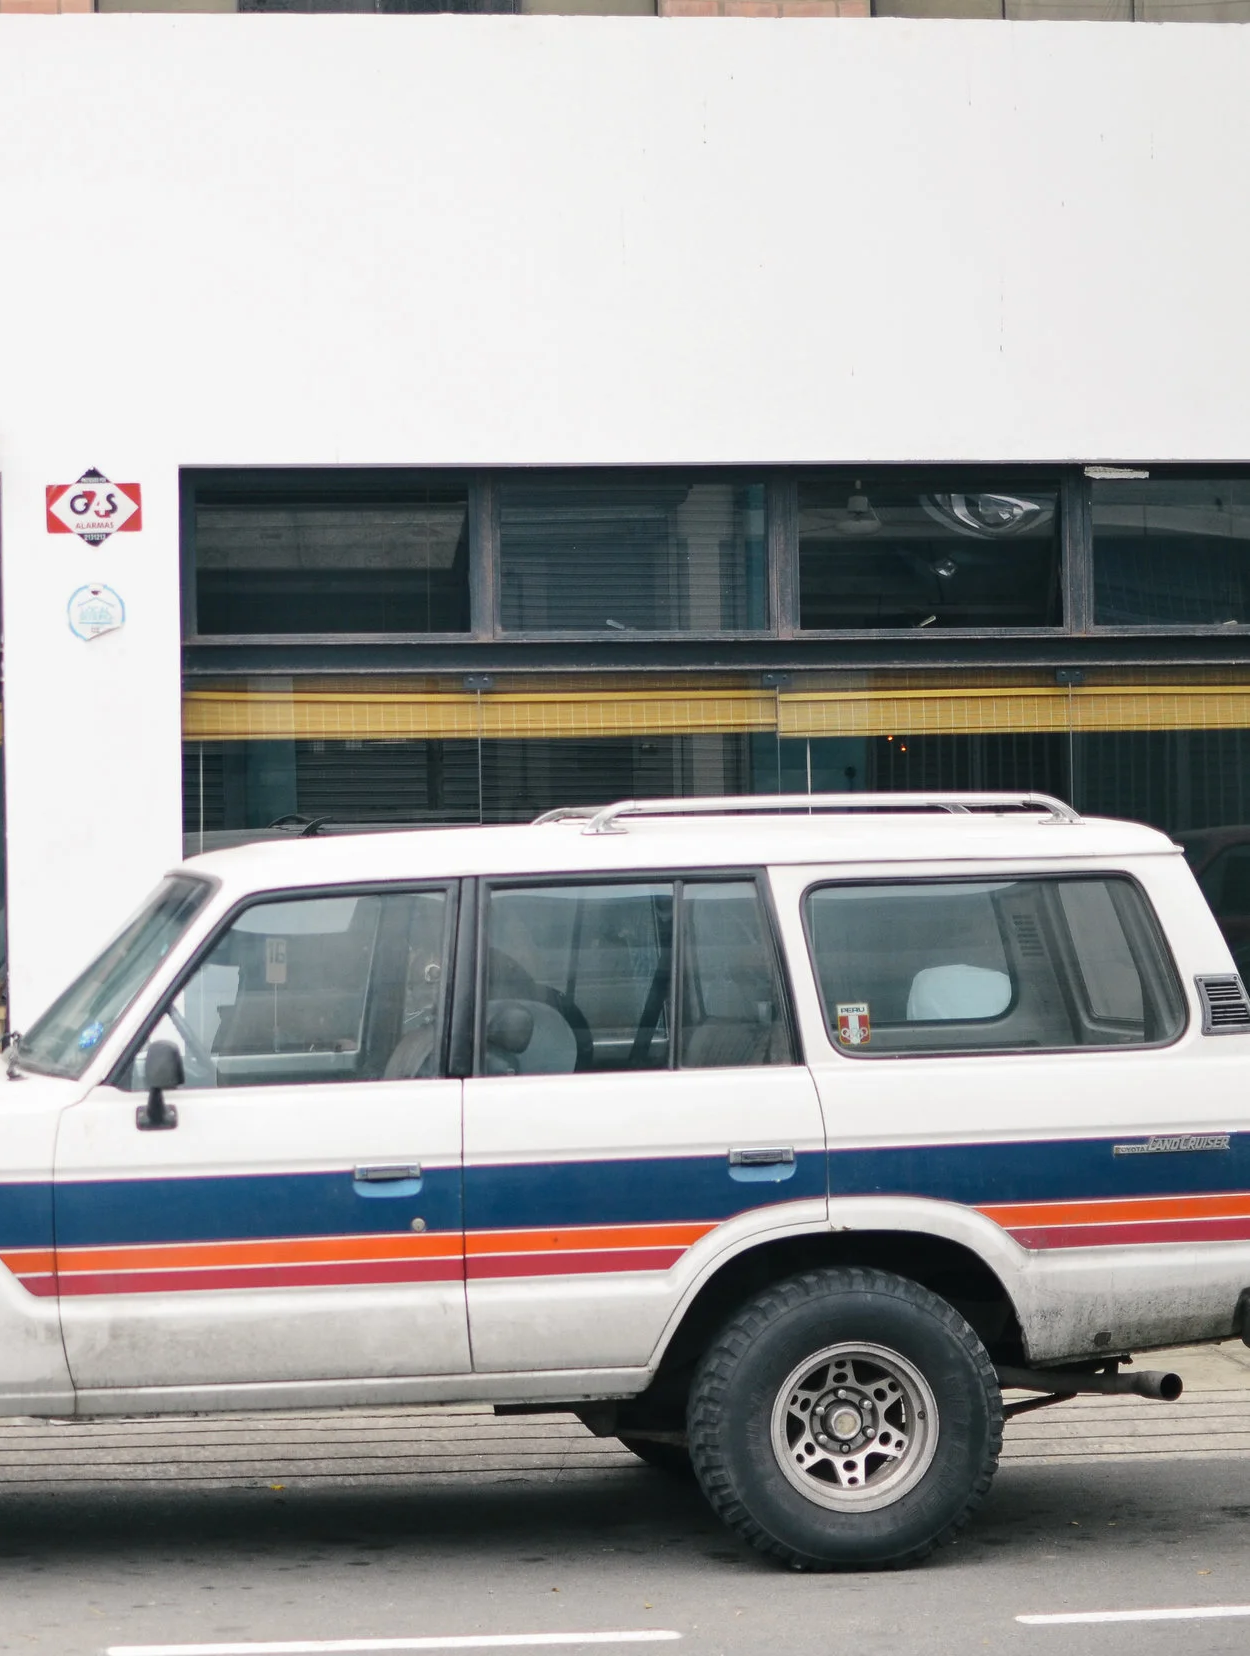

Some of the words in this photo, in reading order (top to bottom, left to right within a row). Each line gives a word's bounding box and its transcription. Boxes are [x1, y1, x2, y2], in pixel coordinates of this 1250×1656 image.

[74, 521, 115, 530] ALARMAS
[840, 1006, 865, 1014] PERU
[1115, 1146, 1146, 1154] TOYOTA
